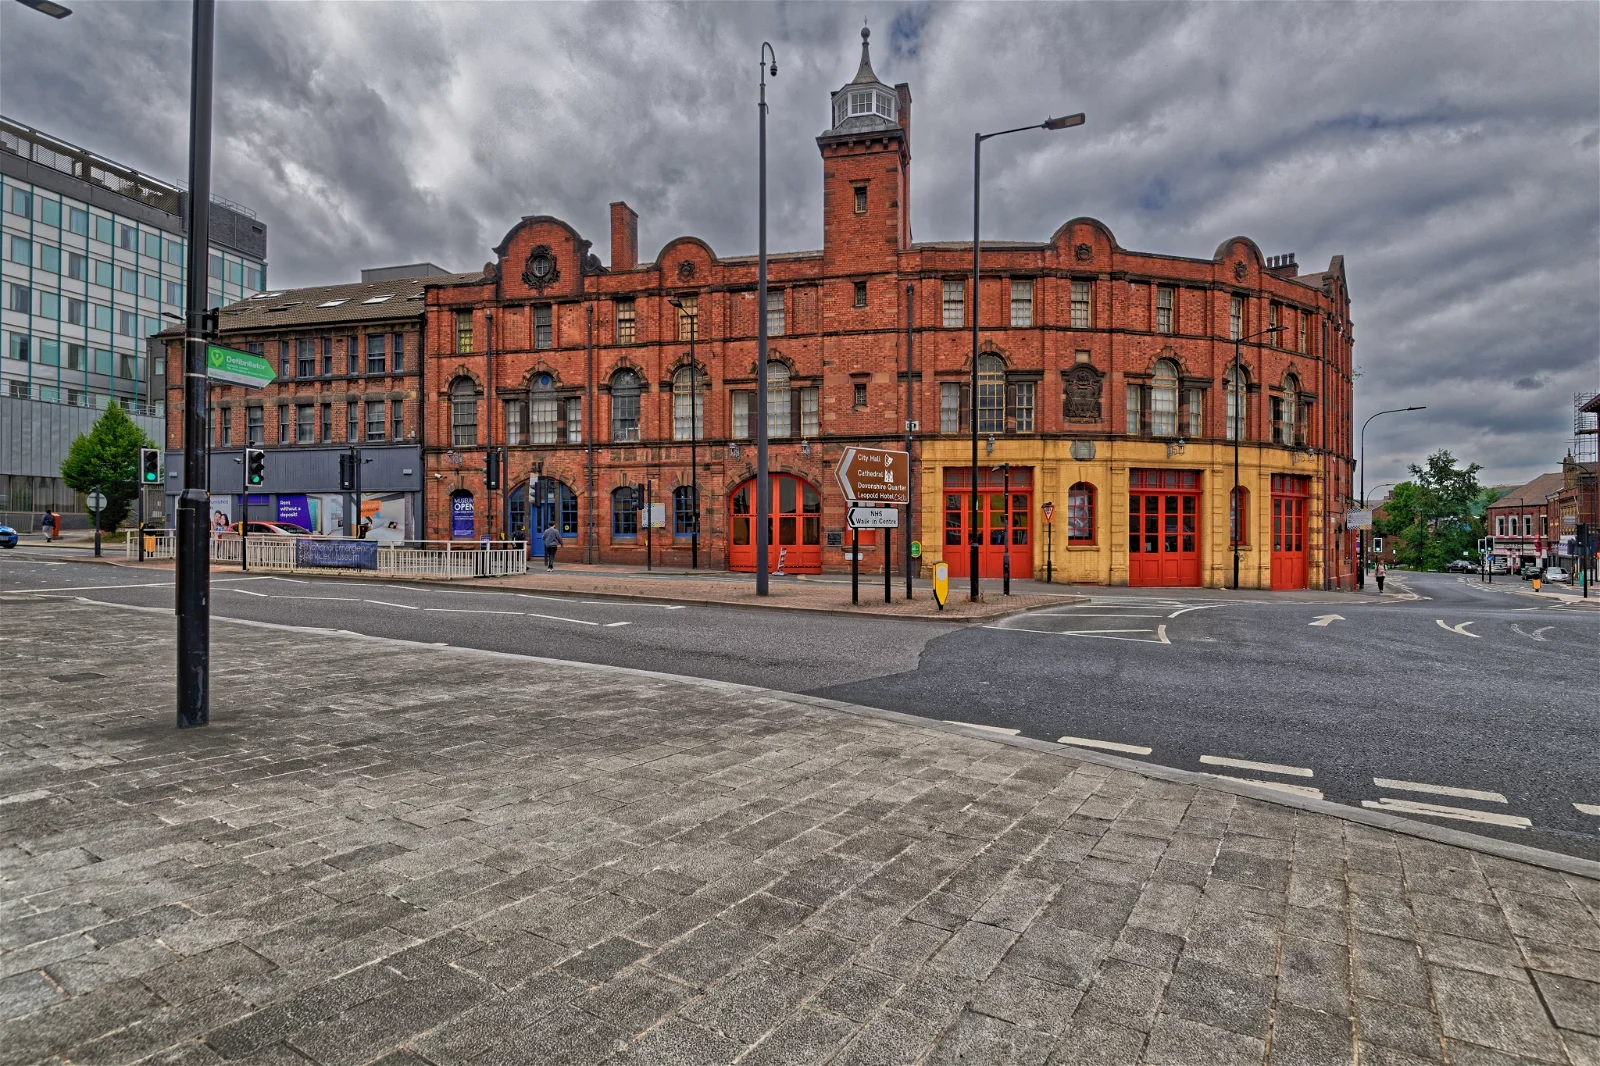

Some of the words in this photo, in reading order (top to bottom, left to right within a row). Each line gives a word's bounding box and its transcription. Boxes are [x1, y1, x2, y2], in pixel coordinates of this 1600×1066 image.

[226, 355, 266, 370] Defibrillator
[857, 453, 869, 462] City
[857, 469, 883, 477] Cathedral
[857, 482, 887, 490] Devonshire
[887, 483, 906, 491] Quarter
[857, 492, 879, 500] Leopold
[856, 517, 877, 525] Walk-in
